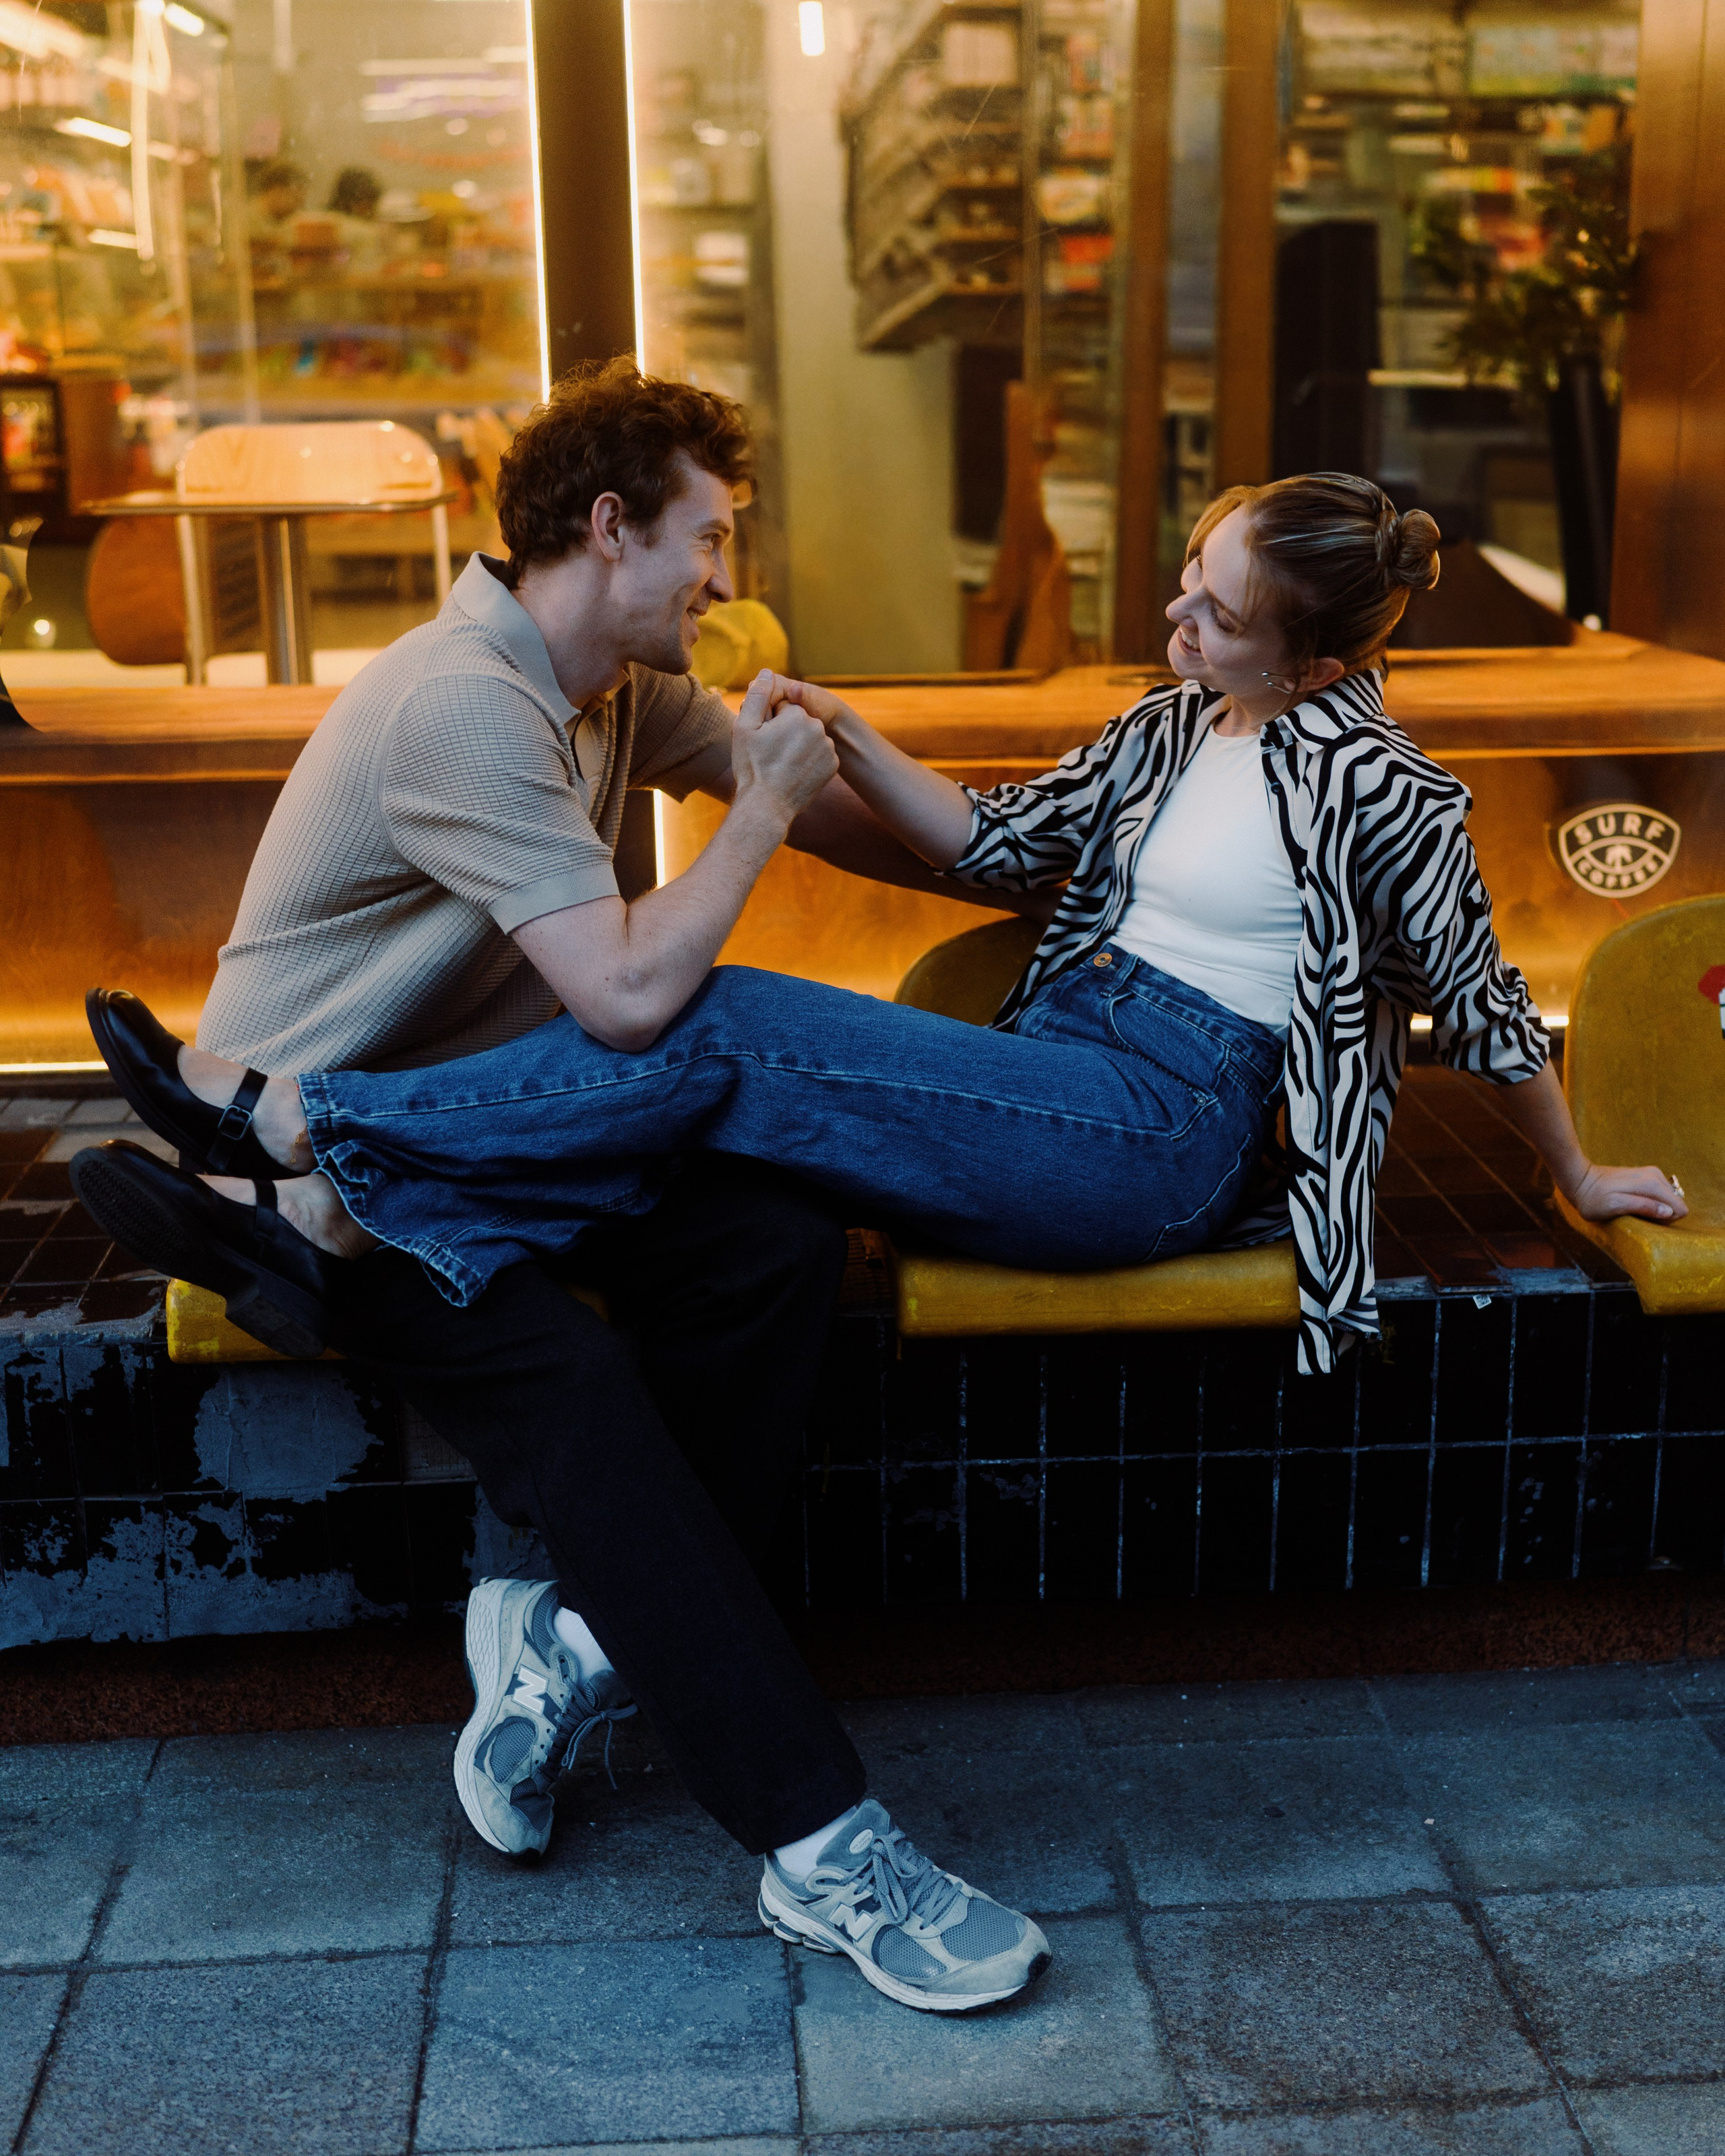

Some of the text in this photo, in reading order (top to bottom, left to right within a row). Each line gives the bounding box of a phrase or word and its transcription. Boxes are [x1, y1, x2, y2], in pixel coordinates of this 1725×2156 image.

[1573, 813, 1666, 846] SURF
[512, 1664, 549, 1715] N
[829, 1903, 877, 1942] N
